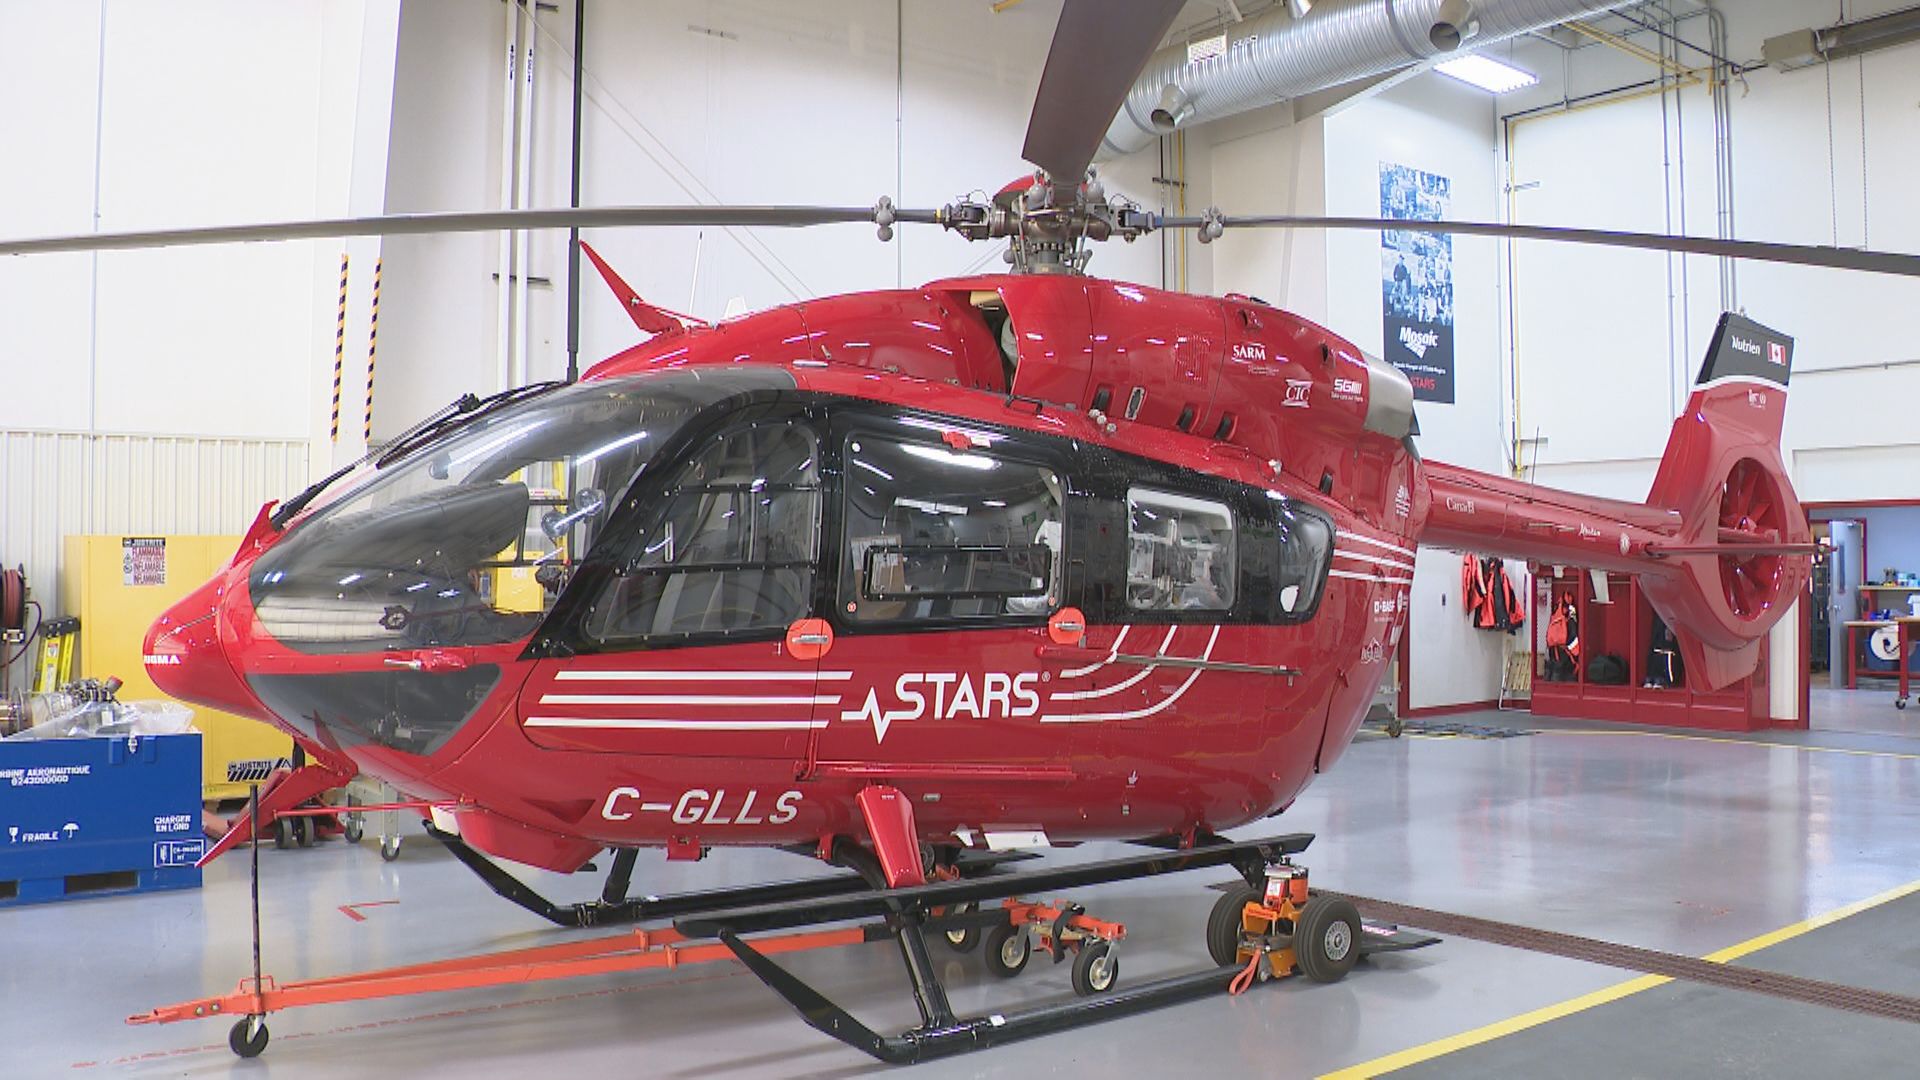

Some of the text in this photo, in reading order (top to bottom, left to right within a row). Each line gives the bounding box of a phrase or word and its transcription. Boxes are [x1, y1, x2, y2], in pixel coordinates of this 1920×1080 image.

[1400, 327, 1439, 347] Mosaic
[1232, 344, 1266, 360] SARM
[1731, 336, 1761, 355] Nutrien
[1410, 376, 1437, 390] STARS
[1285, 386, 1312, 401] CIC
[132, 547, 165, 556] FLAMMABLE
[894, 672, 1040, 721] STARS
[238, 760, 272, 770] JUSTRITE
[601, 786, 804, 825] C-GLLS
[153, 815, 191, 825] CHARGER
[155, 824, 167, 832] EN
[22, 831, 59, 843] FRAGILE
